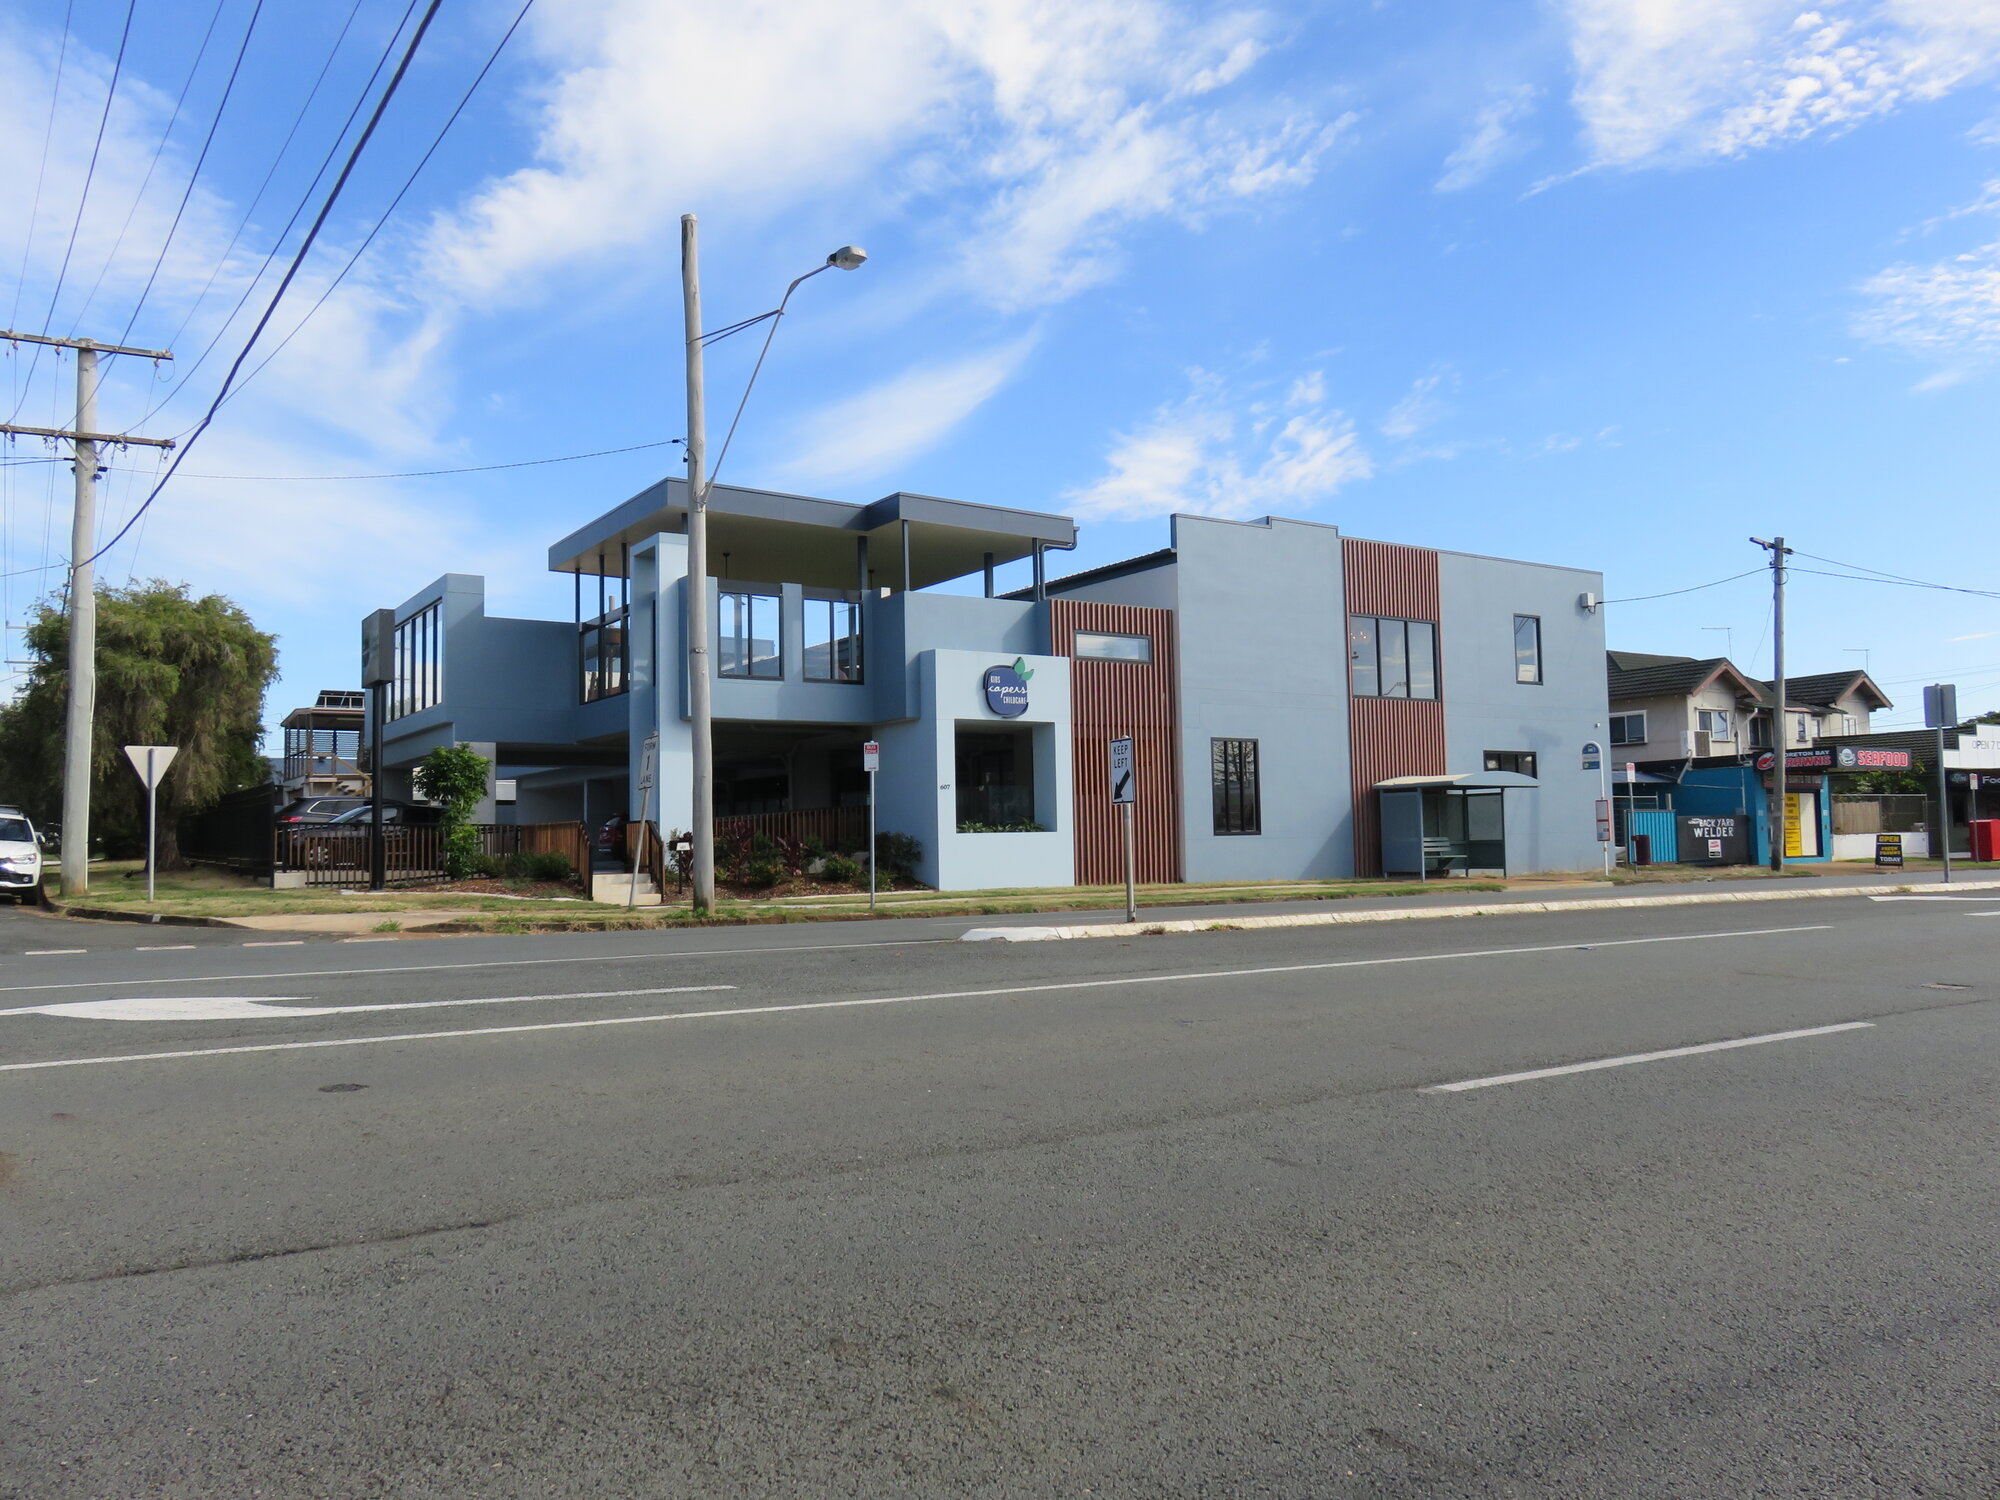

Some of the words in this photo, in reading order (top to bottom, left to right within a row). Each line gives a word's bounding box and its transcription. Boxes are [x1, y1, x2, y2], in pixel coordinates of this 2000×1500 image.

[987, 685, 1029, 699] capers
[1003, 696, 1027, 705] CHILDCARE
[1113, 744, 1128, 755] KEEP
[1971, 740, 1990, 750] OPEN
[1113, 757, 1128, 769] LEFT
[1784, 755, 1831, 767] RAWNS
[1857, 751, 1908, 766] SEAFOOD
[1717, 819, 1735, 827] YARD
[1693, 827, 1734, 838] WELDER
